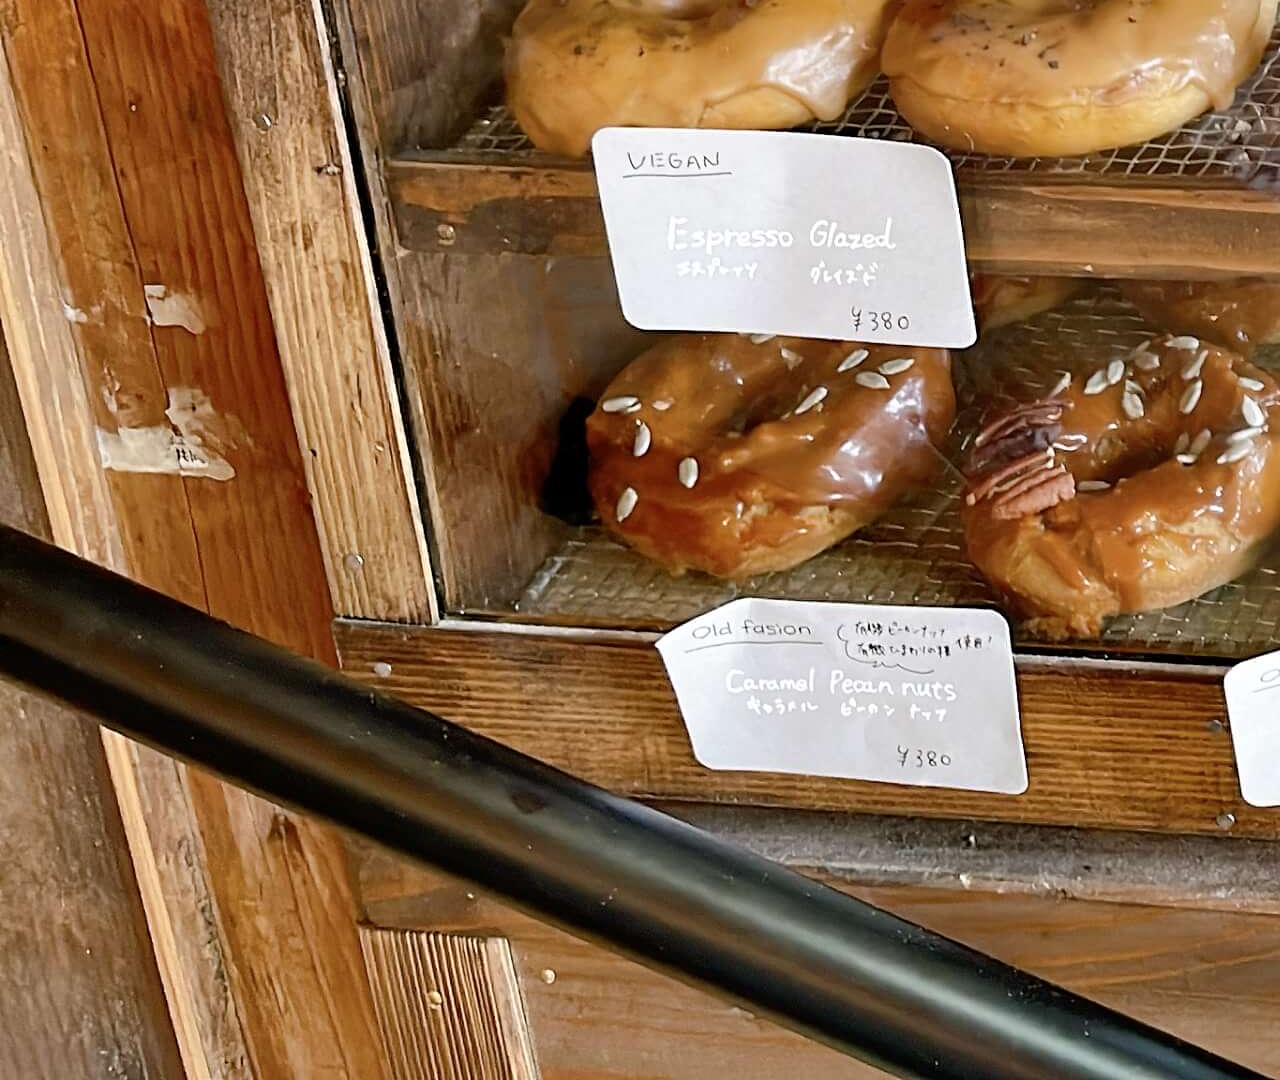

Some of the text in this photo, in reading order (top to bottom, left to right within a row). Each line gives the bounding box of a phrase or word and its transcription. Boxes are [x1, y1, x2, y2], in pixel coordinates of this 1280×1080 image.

[627, 152, 720, 170] VEGAN
[666, 217, 897, 255] Espresso Glazed
[851, 306, 910, 331] ¥380
[691, 619, 812, 640] Old fasion
[726, 666, 958, 702] Caramel Pecan nuts
[896, 744, 952, 768] ¥380
